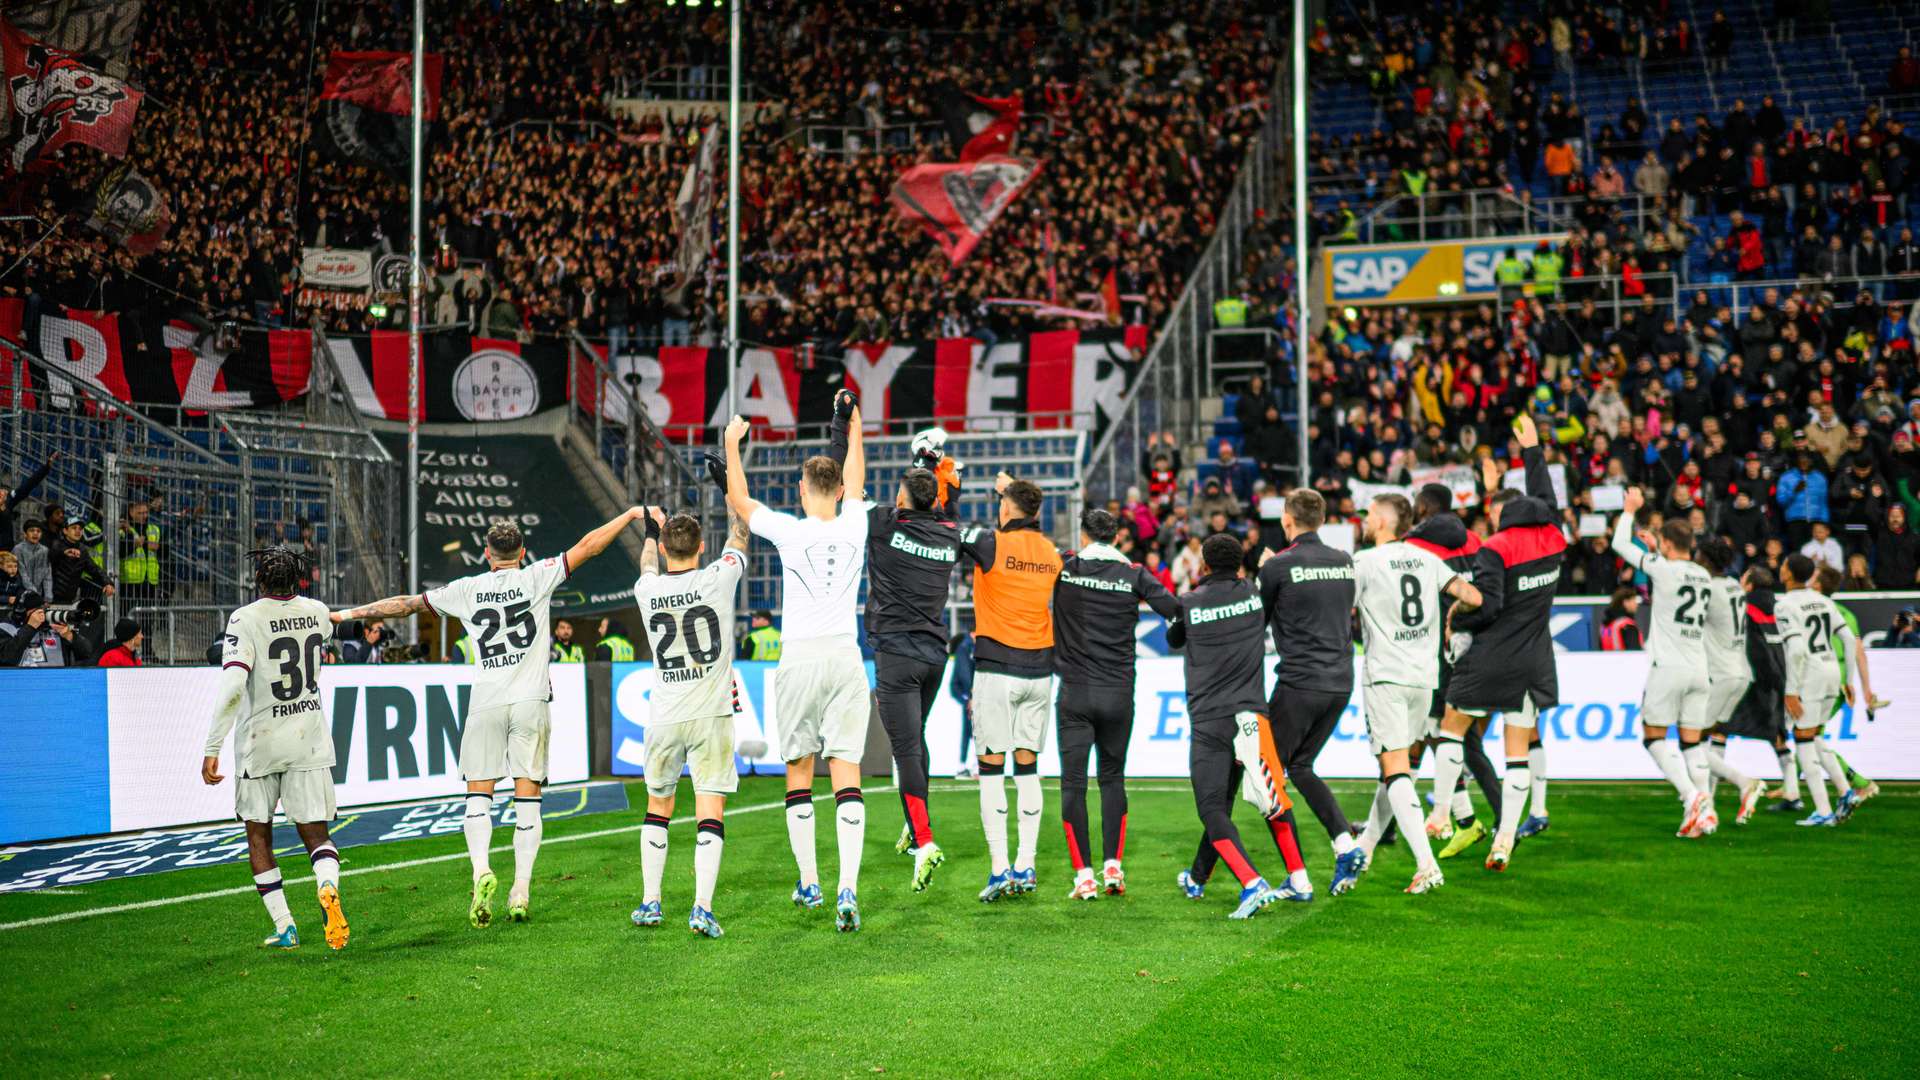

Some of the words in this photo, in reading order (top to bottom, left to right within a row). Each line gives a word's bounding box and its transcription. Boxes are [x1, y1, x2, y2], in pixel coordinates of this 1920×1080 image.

[1334, 257, 1406, 293] SAP
[472, 385, 522, 396] BAYER
[603, 342, 1131, 431] BAYER
[416, 449, 489, 468] Zero
[435, 491, 513, 507] Alles
[1190, 595, 1263, 625] Barmenia
[1400, 573, 1424, 627] 8
[471, 600, 537, 659] 25
[649, 604, 722, 670] 20
[1805, 612, 1832, 654] 21
